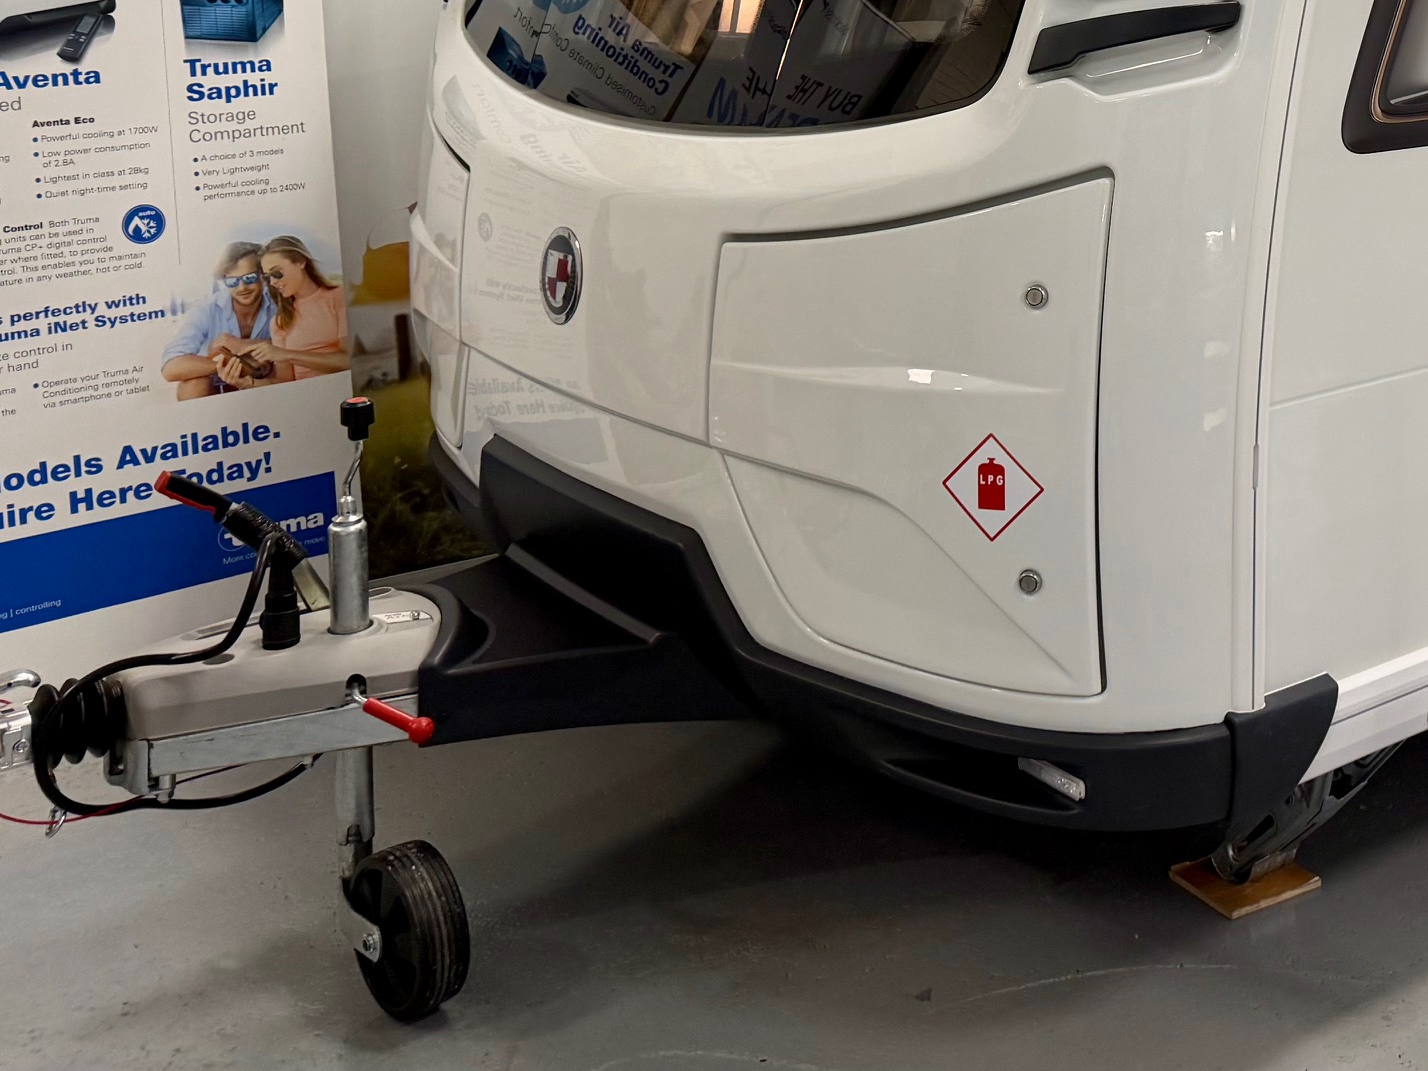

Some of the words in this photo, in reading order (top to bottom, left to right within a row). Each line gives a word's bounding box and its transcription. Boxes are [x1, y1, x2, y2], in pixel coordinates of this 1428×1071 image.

[183, 58, 272, 77] Truma
[0, 68, 101, 90] Aventa
[186, 78, 278, 103] Saphir
[32, 117, 70, 128] Aventa
[74, 116, 95, 125] Eco
[188, 109, 256, 125] Storage
[41, 133, 80, 143] Powerful
[82, 130, 115, 140] cooling
[129, 126, 158, 135] 1700W
[189, 122, 306, 143] Compartment
[64, 148, 92, 158] power
[94, 142, 151, 153] consumption
[200, 154, 208, 162] A
[210, 152, 236, 161] choice
[239, 150, 247, 159] of
[249, 149, 254, 157] 3
[256, 147, 284, 157] models
[44, 174, 80, 184] Lightest
[93, 169, 115, 179] class
[117, 168, 126, 176] at
[201, 168, 220, 177] Very
[222, 163, 270, 175] Lightweight
[45, 189, 69, 199] Quiet
[71, 184, 116, 197] night-time
[118, 181, 148, 192] setting
[203, 181, 239, 191] Powerful
[240, 177, 270, 187] cooling
[203, 189, 255, 202] performance
[279, 182, 306, 192] 2400W
[3, 222, 43, 233] Control
[49, 219, 70, 228] Both
[71, 216, 100, 226] Truma
[5, 235, 27, 244] units
[29, 233, 46, 241] can
[48, 230, 60, 239] be
[62, 228, 83, 237] used
[86, 226, 95, 234] in
[46, 239, 74, 250] digital
[77, 235, 107, 245] control
[10, 255, 39, 265] where
[69, 249, 78, 257] to
[81, 245, 114, 256] provide
[21, 265, 39, 274] This
[41, 260, 76, 271] enables
[78, 258, 95, 268] you
[97, 256, 106, 264] to
[109, 251, 146, 263] maintain
[26, 275, 33, 283] in
[36, 273, 52, 283] any
[55, 268, 93, 279] weather,
[96, 265, 110, 274] hot
[113, 264, 121, 272] or
[10, 300, 99, 326] perfectly
[104, 293, 147, 310] with
[47, 319, 88, 335] iNet
[94, 308, 166, 329] System
[13, 342, 57, 359] control
[62, 341, 73, 352] in
[7, 359, 39, 373] hand
[41, 376, 78, 389] Operate
[80, 373, 100, 384] your
[101, 369, 129, 379] Truma
[132, 365, 144, 374] Air
[42, 384, 99, 399] Conditioning
[101, 376, 140, 389] remotely
[43, 401, 56, 409] via
[59, 392, 112, 407] smartphone
[114, 389, 124, 397] or
[126, 385, 150, 396] tablet
[1, 408, 16, 417] the
[0, 454, 103, 493] odels
[116, 421, 281, 470] Available.
[980, 474, 1003, 486] LPG
[69, 480, 153, 515] Here
[224, 512, 324, 547] tma
[15, 598, 62, 616] controlling
